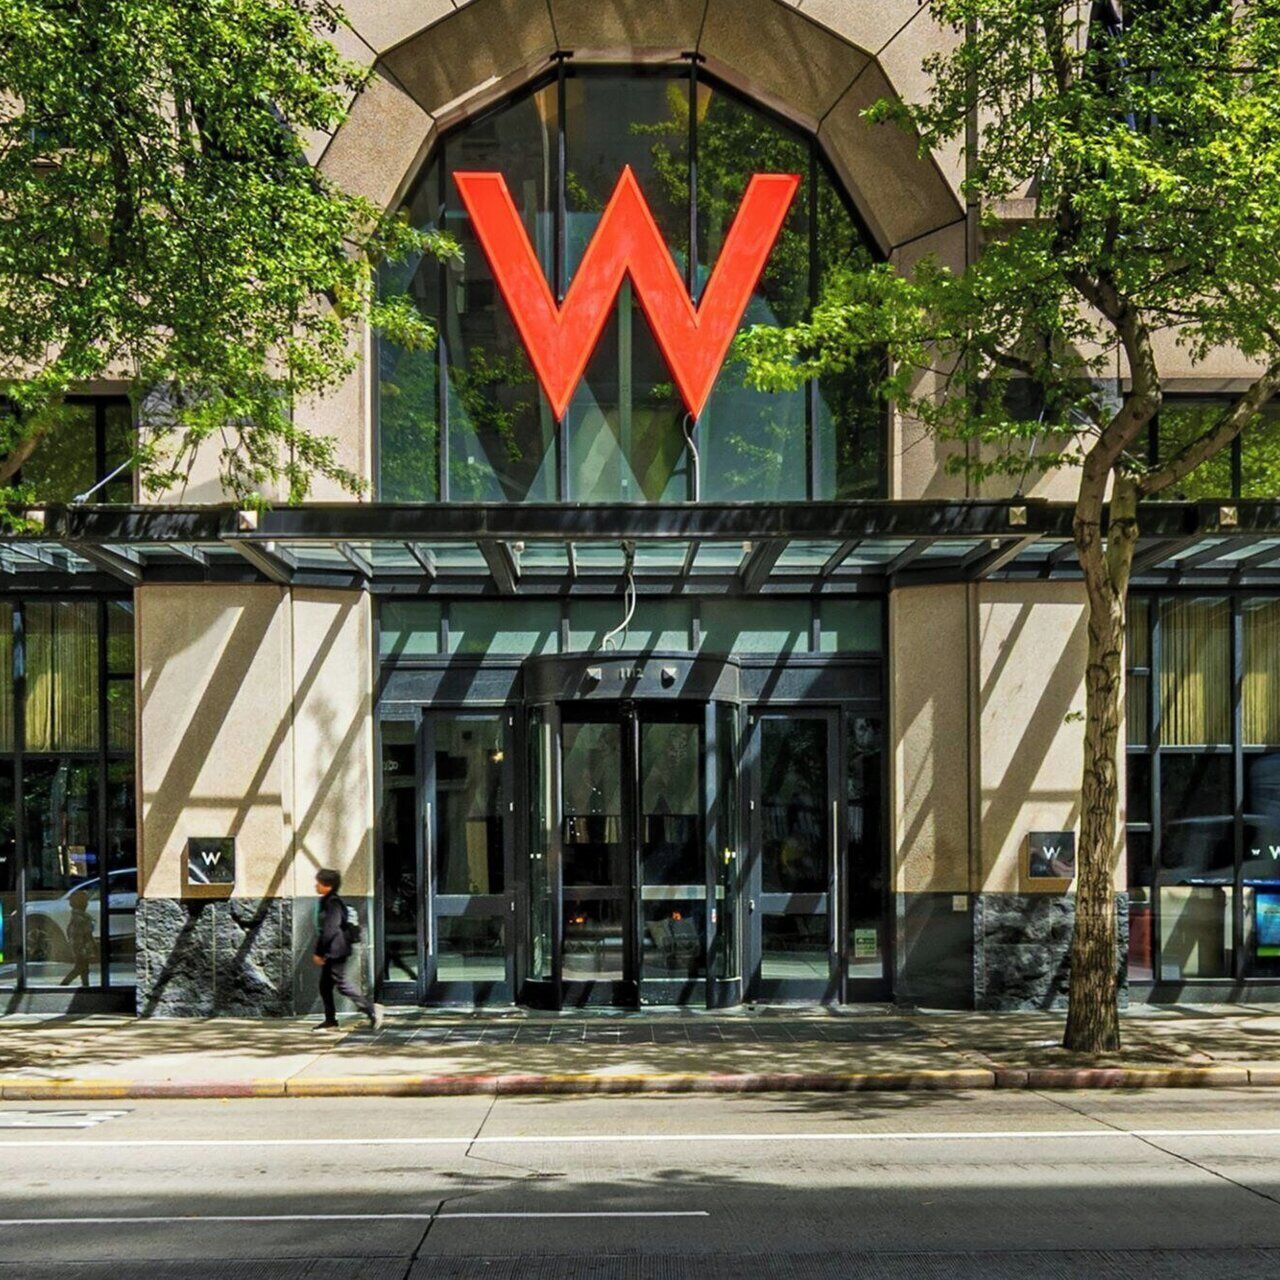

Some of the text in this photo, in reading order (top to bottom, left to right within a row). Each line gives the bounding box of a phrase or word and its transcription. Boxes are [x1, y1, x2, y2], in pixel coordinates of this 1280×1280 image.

[452, 163, 802, 423] W
[201, 851, 221, 866] W
[1042, 846, 1061, 860] W
